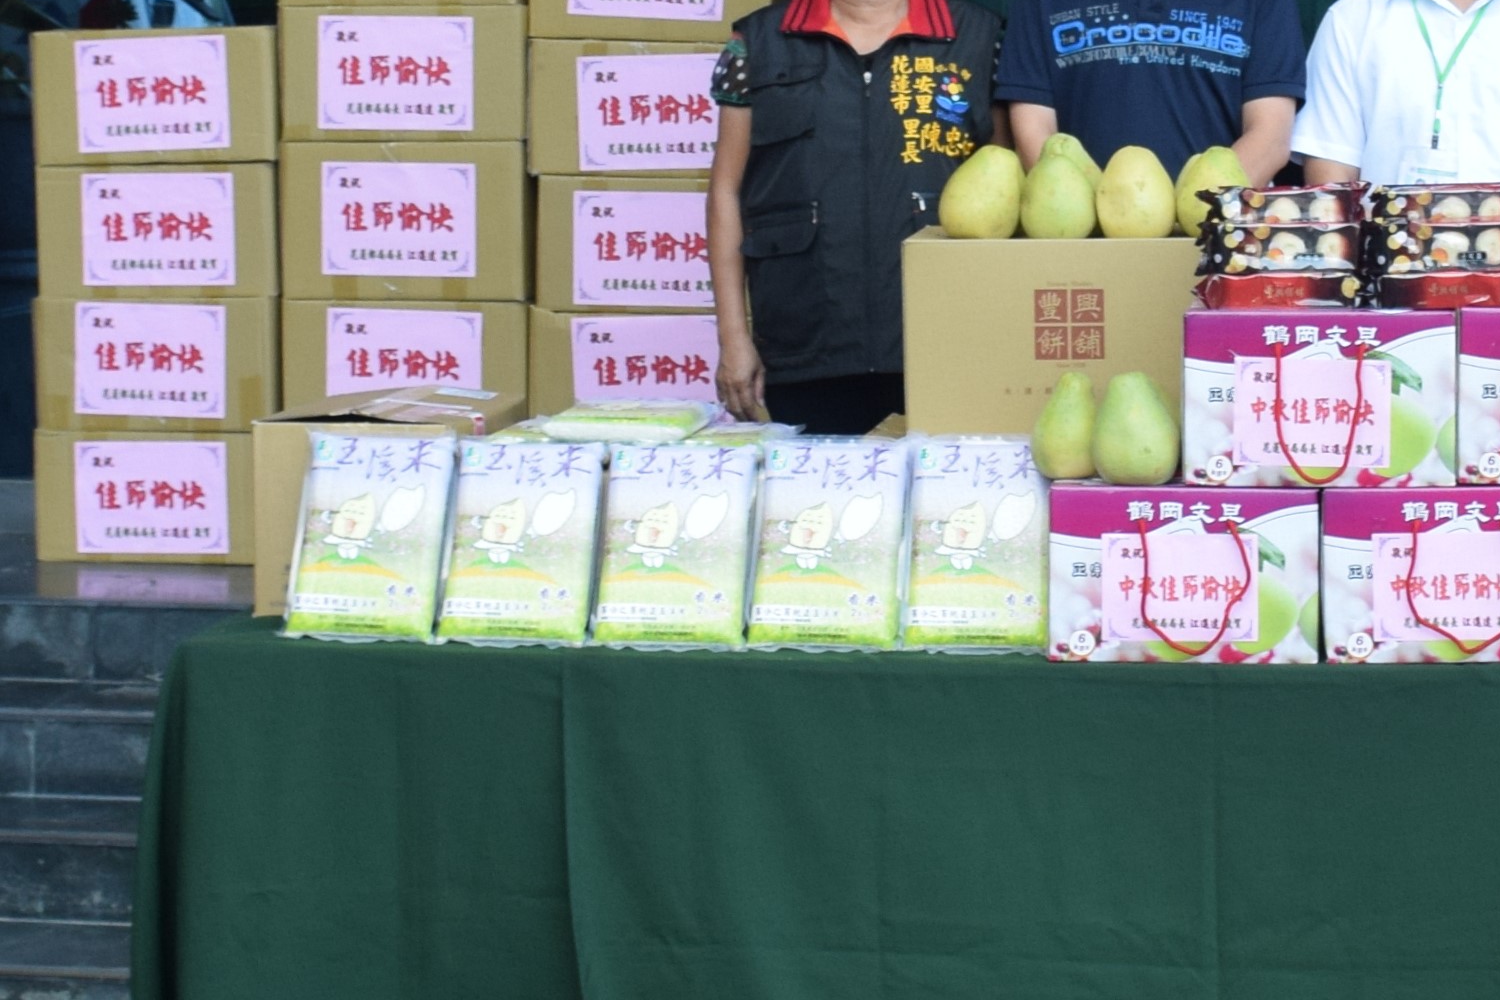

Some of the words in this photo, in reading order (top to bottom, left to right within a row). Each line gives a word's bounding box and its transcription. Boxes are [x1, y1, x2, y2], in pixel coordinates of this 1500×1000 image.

[1086, 3, 1120, 18] STYLE
[1169, 9, 1208, 24] SINCE
[1052, 20, 1248, 58] Crocodile
[338, 55, 451, 86] 佳節愉快
[1190, 54, 1241, 77] Kingdom
[96, 75, 207, 109] 佳節愉快
[890, 54, 913, 115] 花蓮市
[597, 93, 714, 126] 佳節愉快
[900, 118, 923, 164] 里長
[102, 212, 213, 242] 佳節愉快
[341, 202, 455, 232] 佳節愉快
[593, 231, 709, 263] 佳節愉快
[1038, 291, 1102, 321] 豐興
[1262, 324, 1382, 347] 鶴岡文旦
[95, 341, 204, 373] 佳節愉快
[346, 348, 460, 381] 佳節愉快
[593, 354, 711, 387] 佳節愉快
[1250, 396, 1376, 427] 中秋佳節愉快
[1215, 458, 1224, 469] 6
[1487, 455, 1496, 466] 6
[96, 480, 206, 510] 佳節愉快
[1126, 500, 1246, 523] 鶴岡文旦
[1118, 574, 1244, 602] 中秋佳節愉快
[1077, 633, 1087, 644] 6
[1355, 635, 1364, 646] 6
